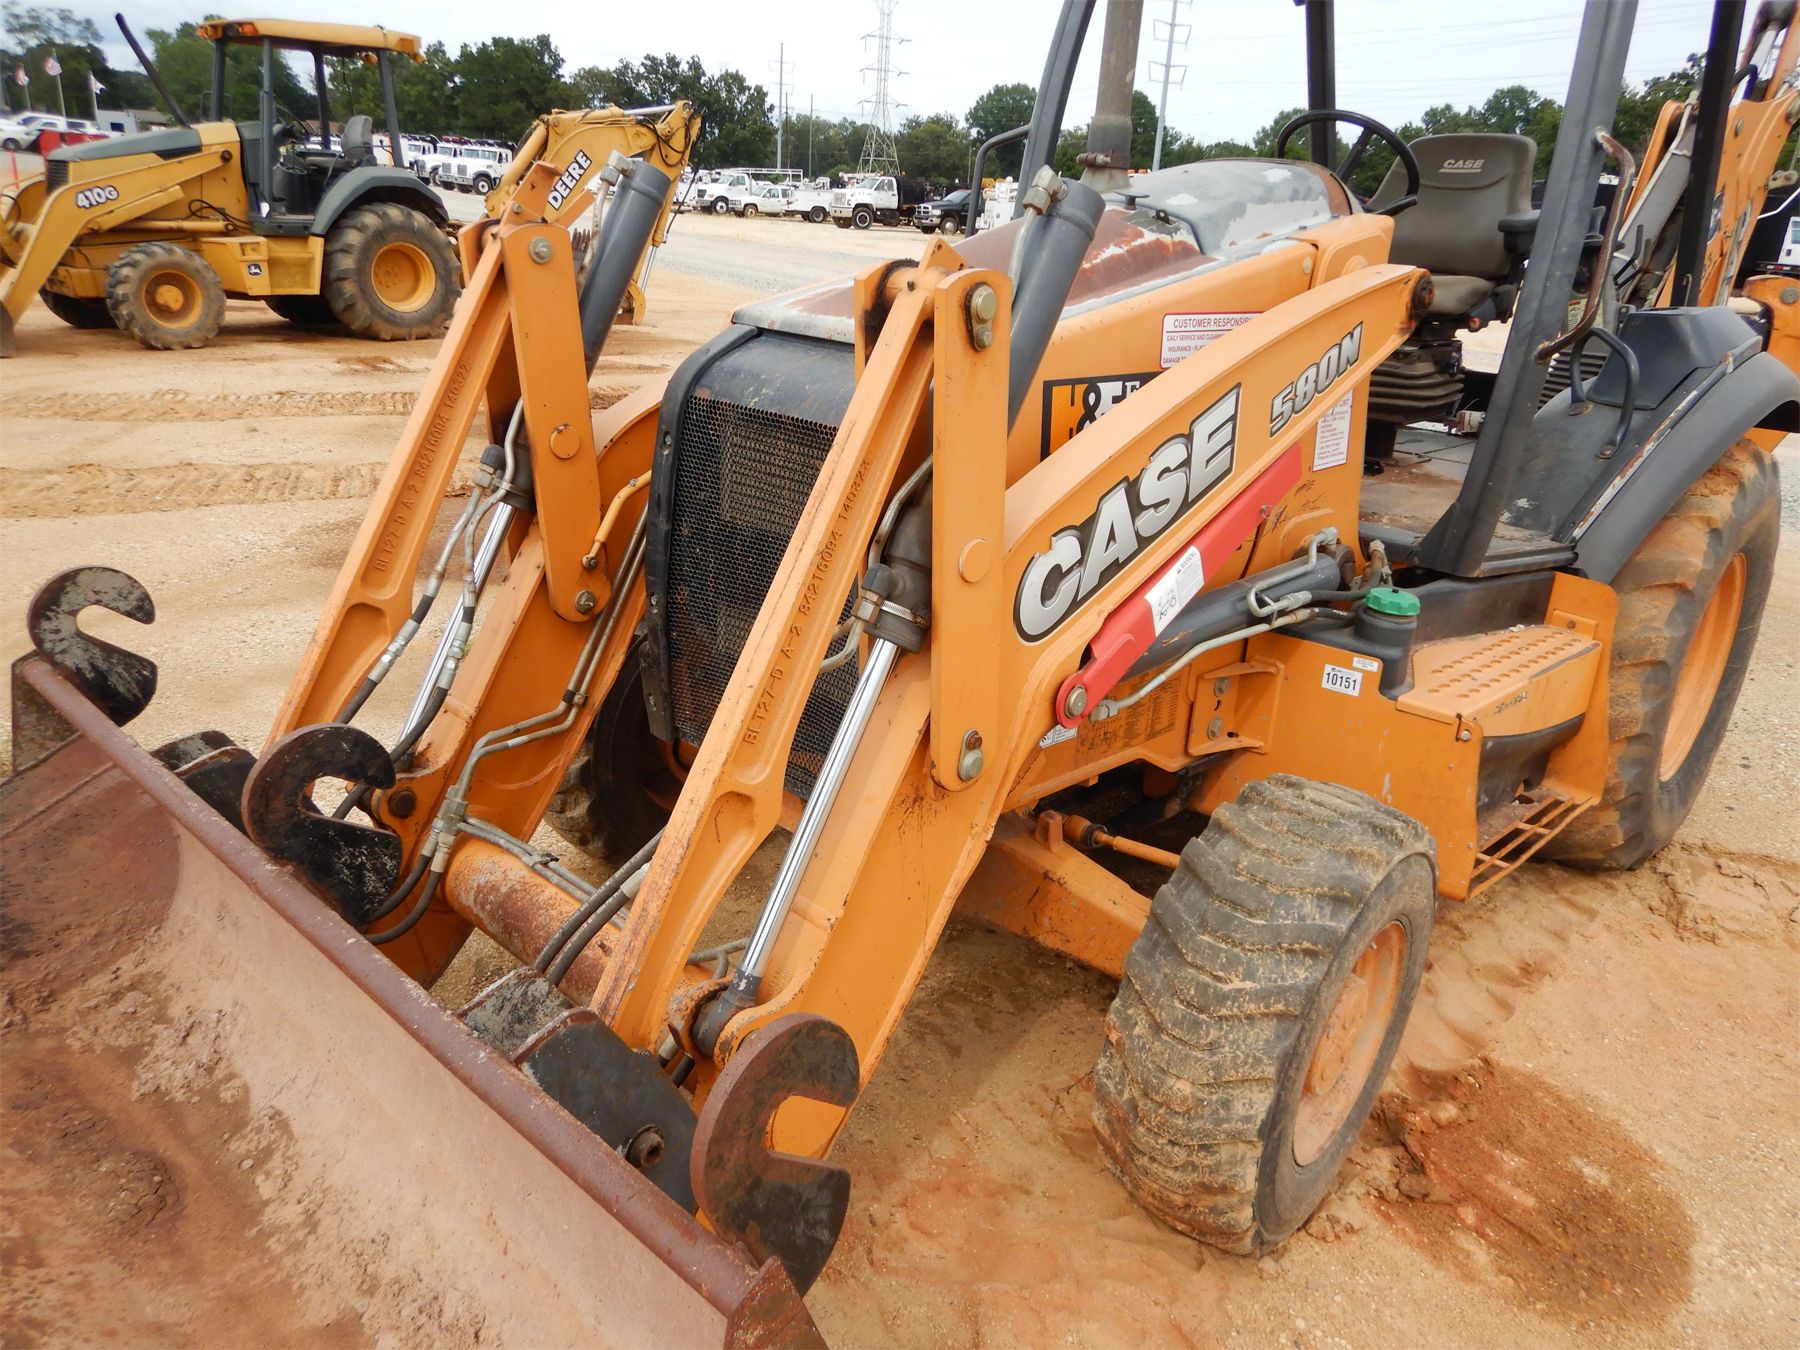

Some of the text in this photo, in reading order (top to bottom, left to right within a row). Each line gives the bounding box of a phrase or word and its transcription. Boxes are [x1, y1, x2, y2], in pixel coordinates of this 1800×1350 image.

[547, 149, 592, 211] DEERE
[1443, 159, 1485, 168] CASE
[76, 185, 119, 209] 410G
[1173, 317, 1211, 329] CUSTOMER
[1270, 321, 1363, 437] 580N
[1014, 384, 1241, 640] CASE
[798, 528, 843, 616] 84216094
[1325, 672, 1357, 691] 10151
